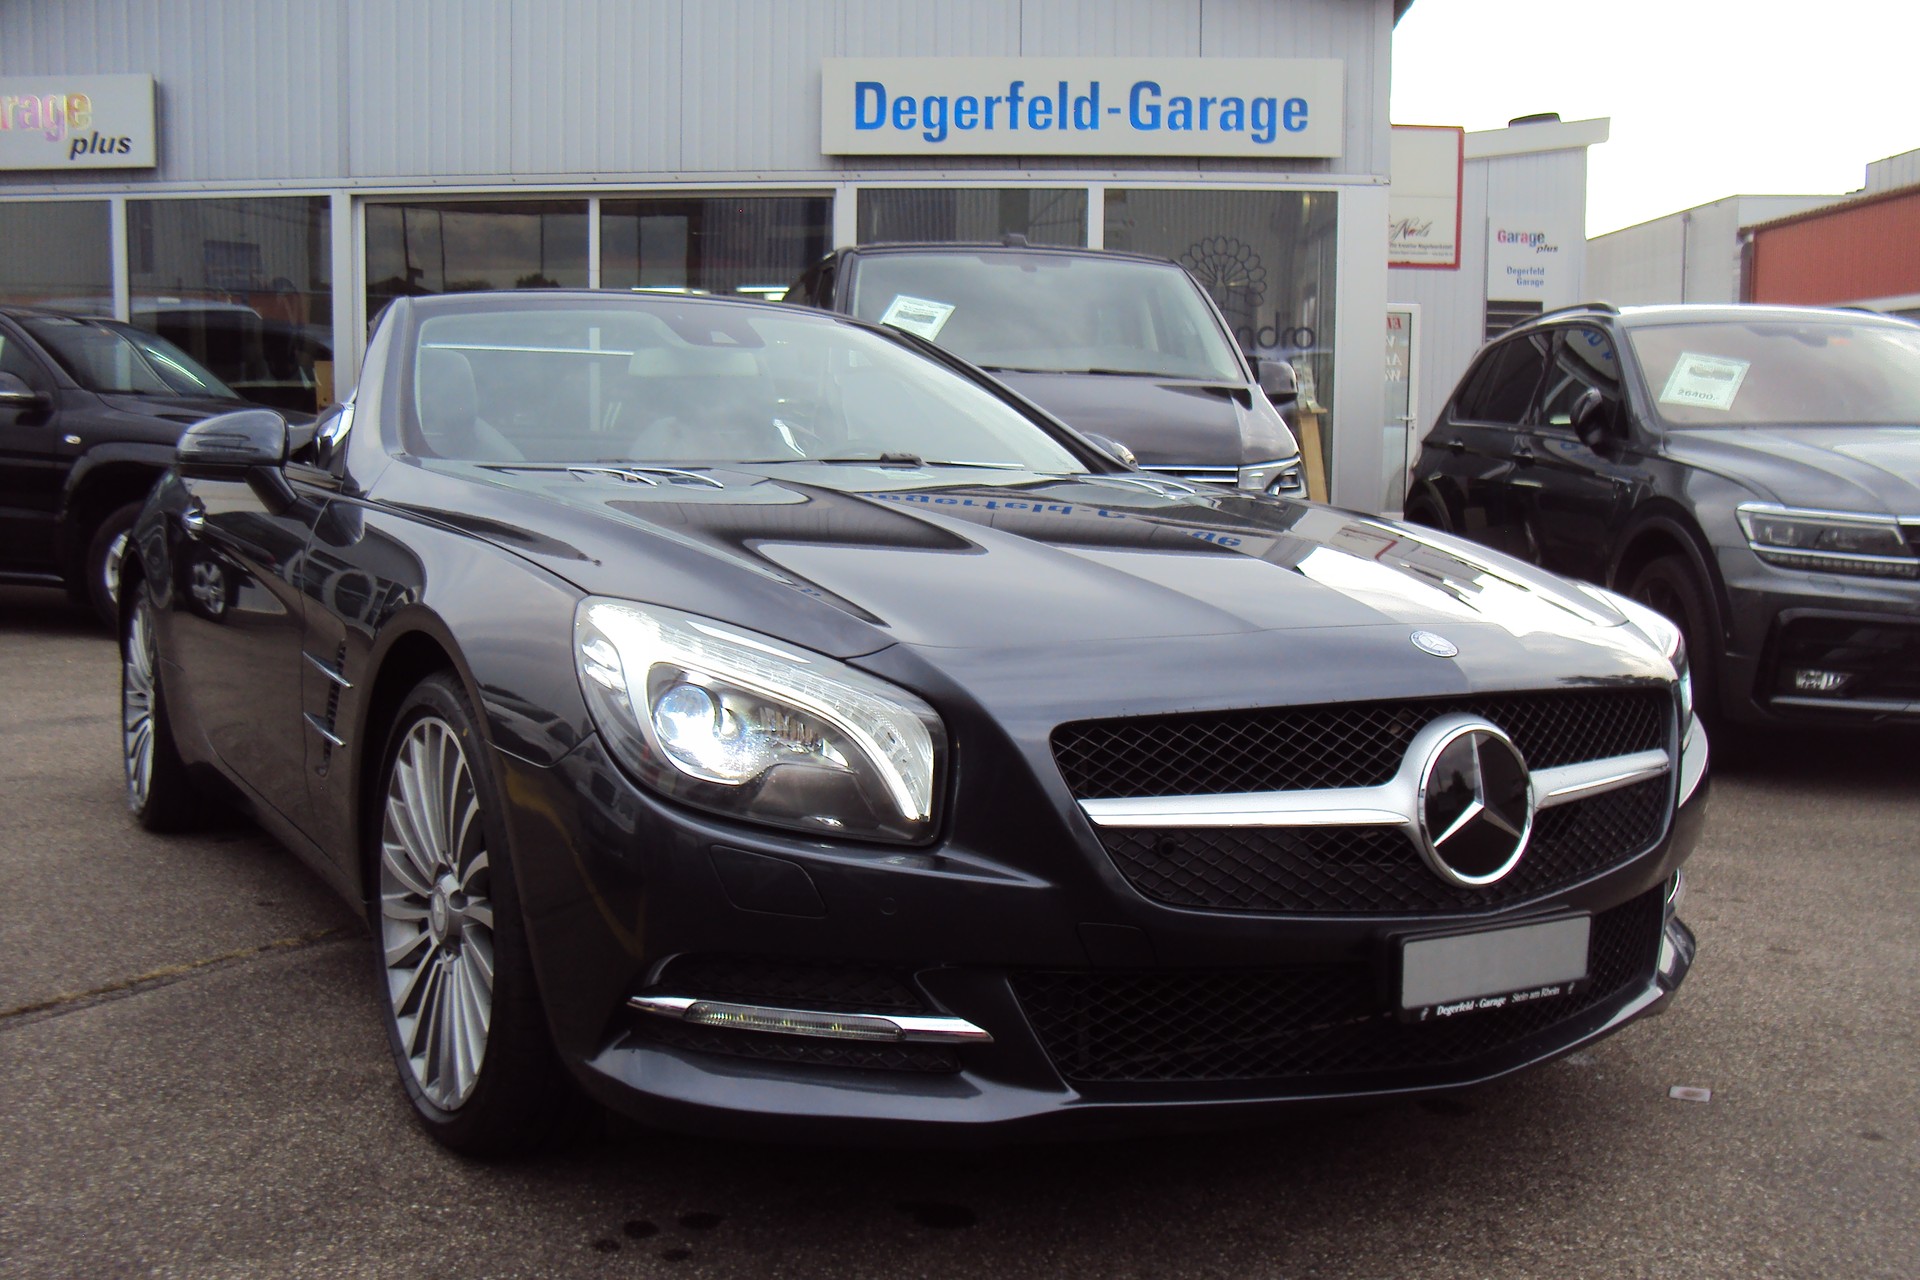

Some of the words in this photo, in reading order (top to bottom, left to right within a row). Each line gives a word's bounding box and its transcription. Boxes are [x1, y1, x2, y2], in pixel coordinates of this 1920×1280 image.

[0, 93, 92, 142] rage
[854, 80, 1309, 144] Degerfeld-Garage
[69, 131, 132, 161] plus
[1497, 229, 1545, 247] Garage
[1536, 244, 1558, 254] plus
[1506, 265, 1545, 276] Degerfeld
[1516, 277, 1545, 287] Garage
[1436, 1000, 1474, 1016] Degerfeld
[1479, 997, 1506, 1008] Garage
[1541, 987, 1560, 998] Rhein
